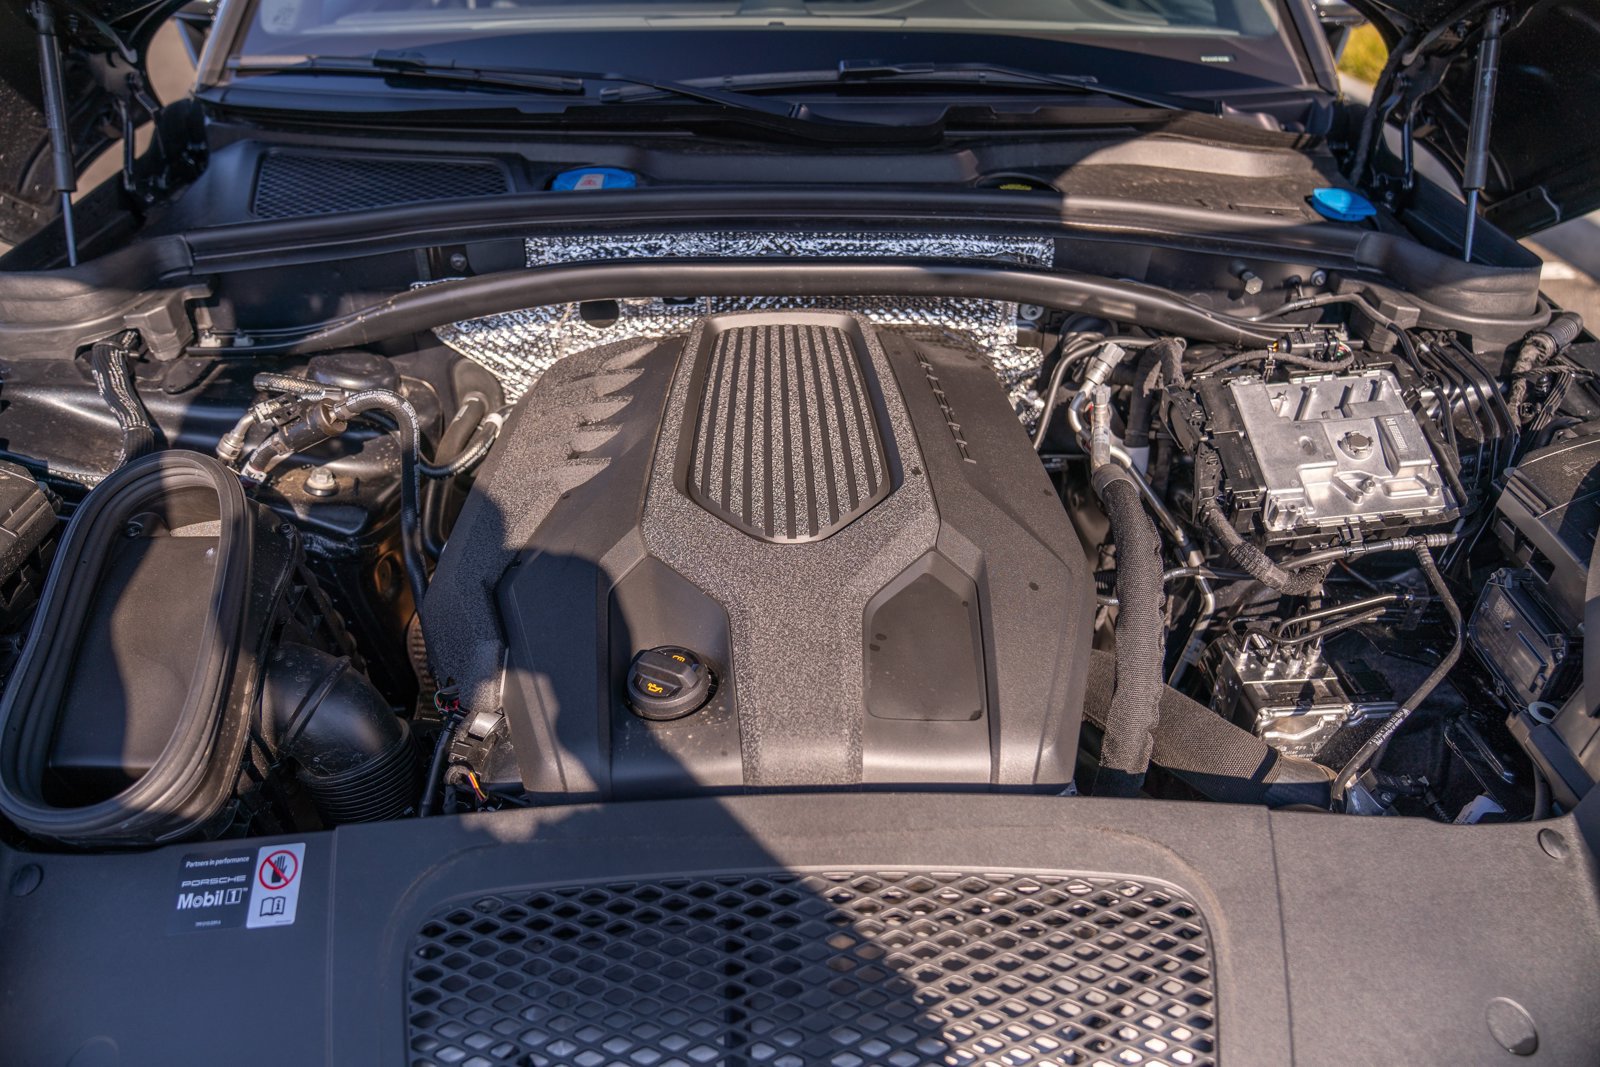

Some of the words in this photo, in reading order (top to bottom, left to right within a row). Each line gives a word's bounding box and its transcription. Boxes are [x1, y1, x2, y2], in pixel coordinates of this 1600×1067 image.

[186, 860, 209, 868] Partners
[215, 856, 250, 866] performance
[181, 875, 247, 888] PORSCHE
[177, 889, 225, 910] Mobil
